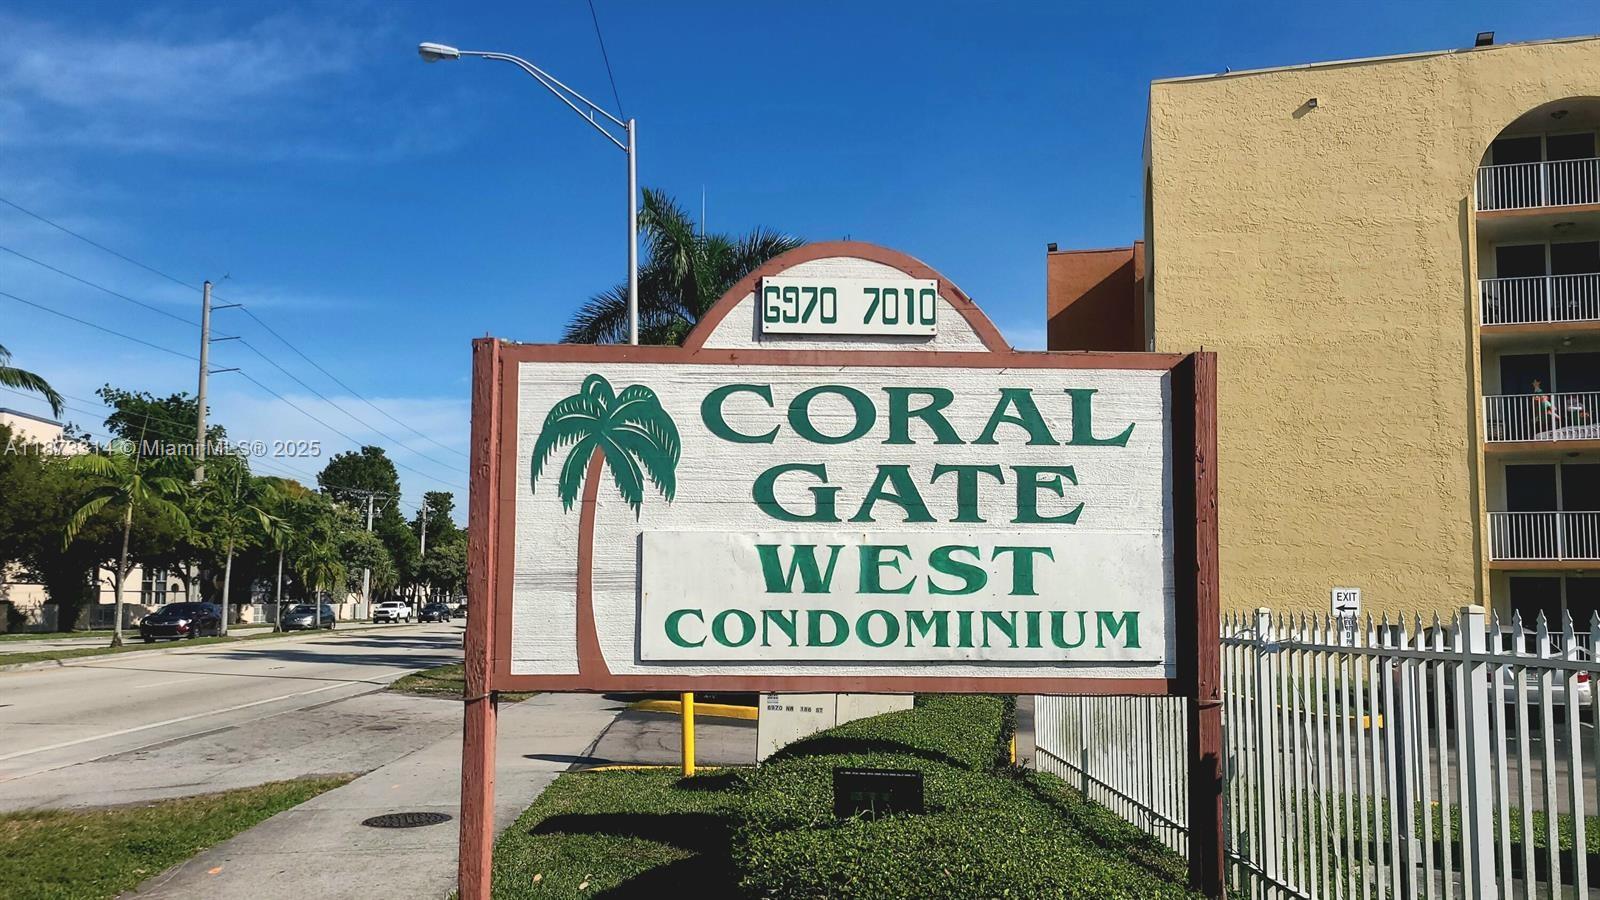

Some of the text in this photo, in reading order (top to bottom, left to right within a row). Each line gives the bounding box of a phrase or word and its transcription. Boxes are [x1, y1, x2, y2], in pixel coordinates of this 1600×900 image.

[863, 287, 936, 325] 7010
[700, 383, 1136, 447] CORAL
[751, 462, 1086, 525] GATE
[753, 543, 1056, 596] WEST
[1336, 592, 1357, 601] EXIT
[663, 607, 1142, 649] CONDOMINIUM
